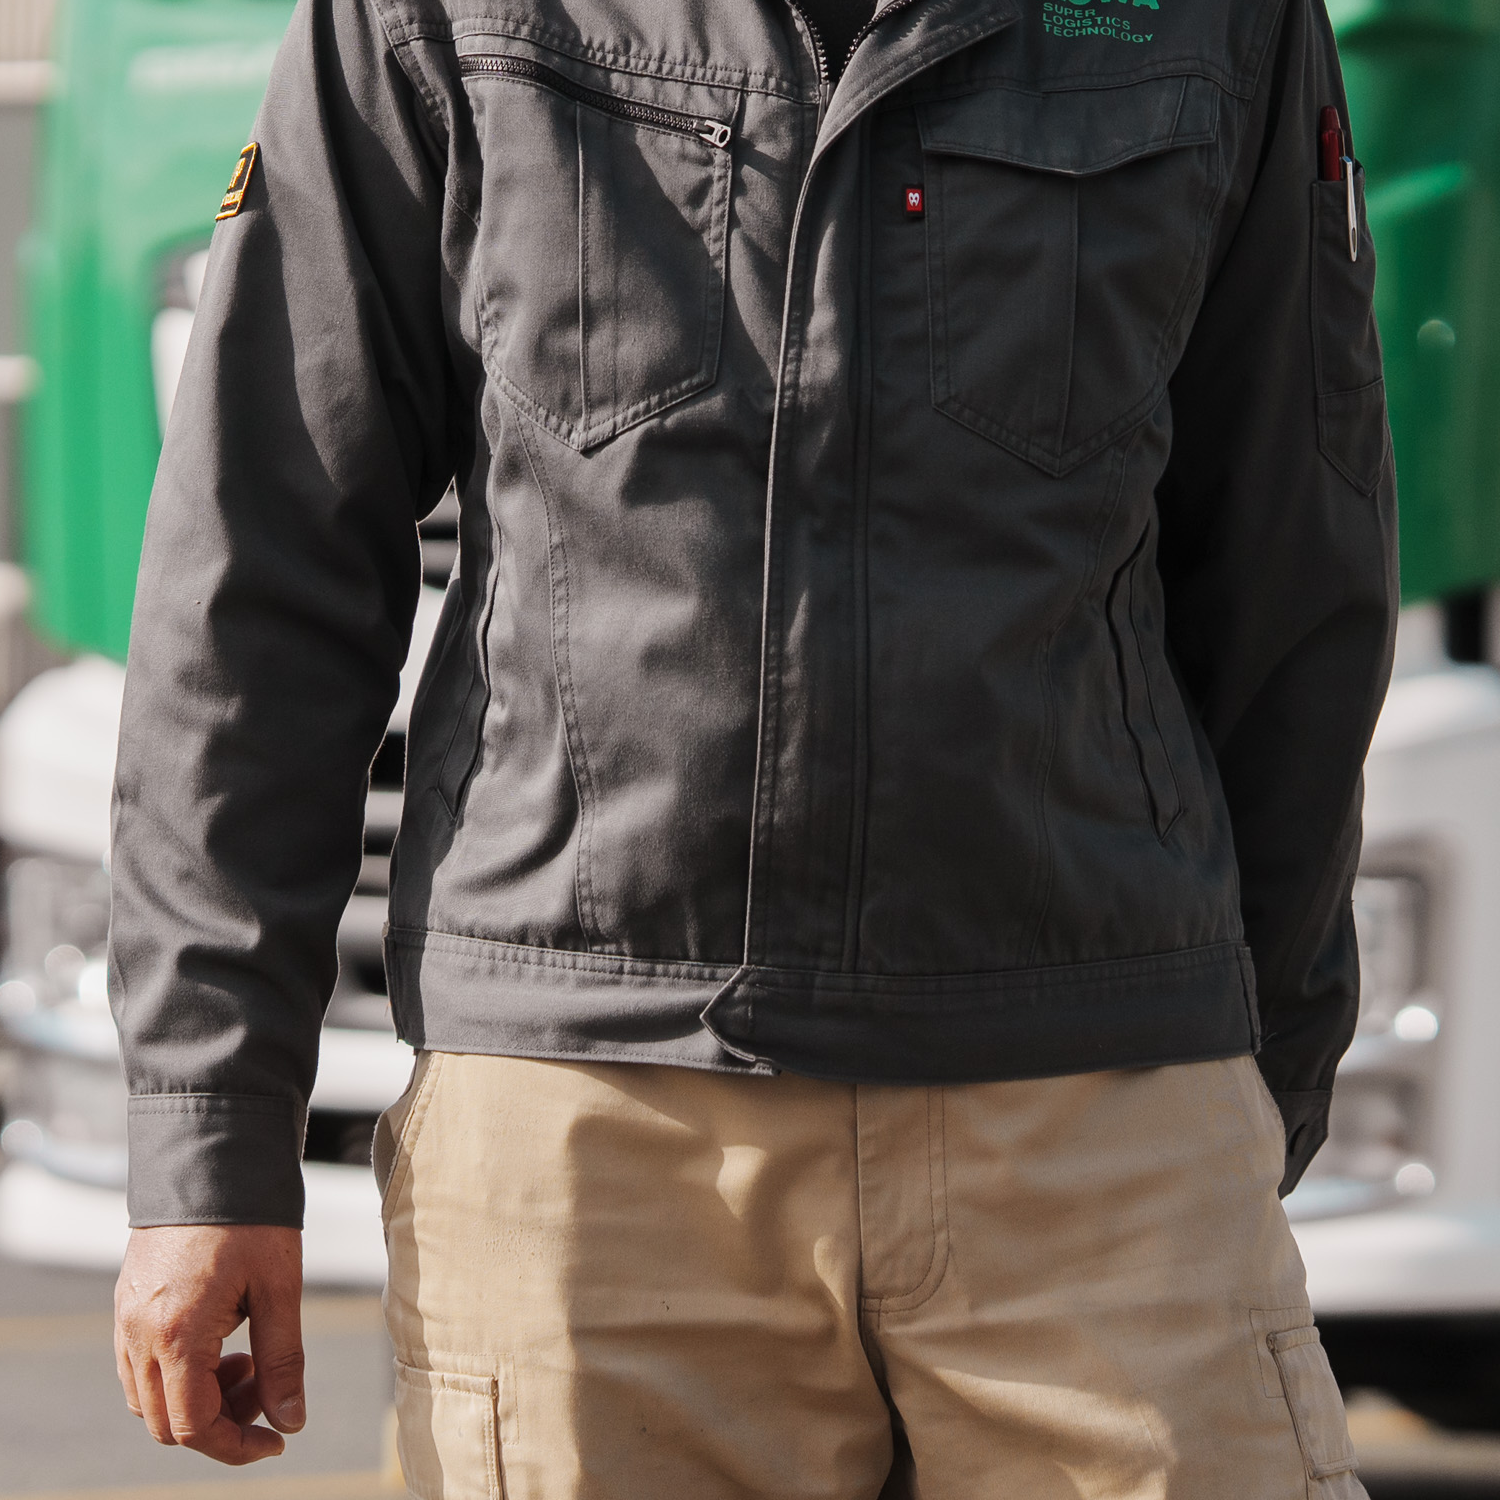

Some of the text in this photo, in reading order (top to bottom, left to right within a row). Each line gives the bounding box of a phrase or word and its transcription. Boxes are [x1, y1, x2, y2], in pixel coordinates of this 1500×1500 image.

[1043, 2, 1096, 19] SUPER
[1042, 13, 1131, 30] LOGISTICS
[1043, 23, 1154, 43] TECHNOLOGY
